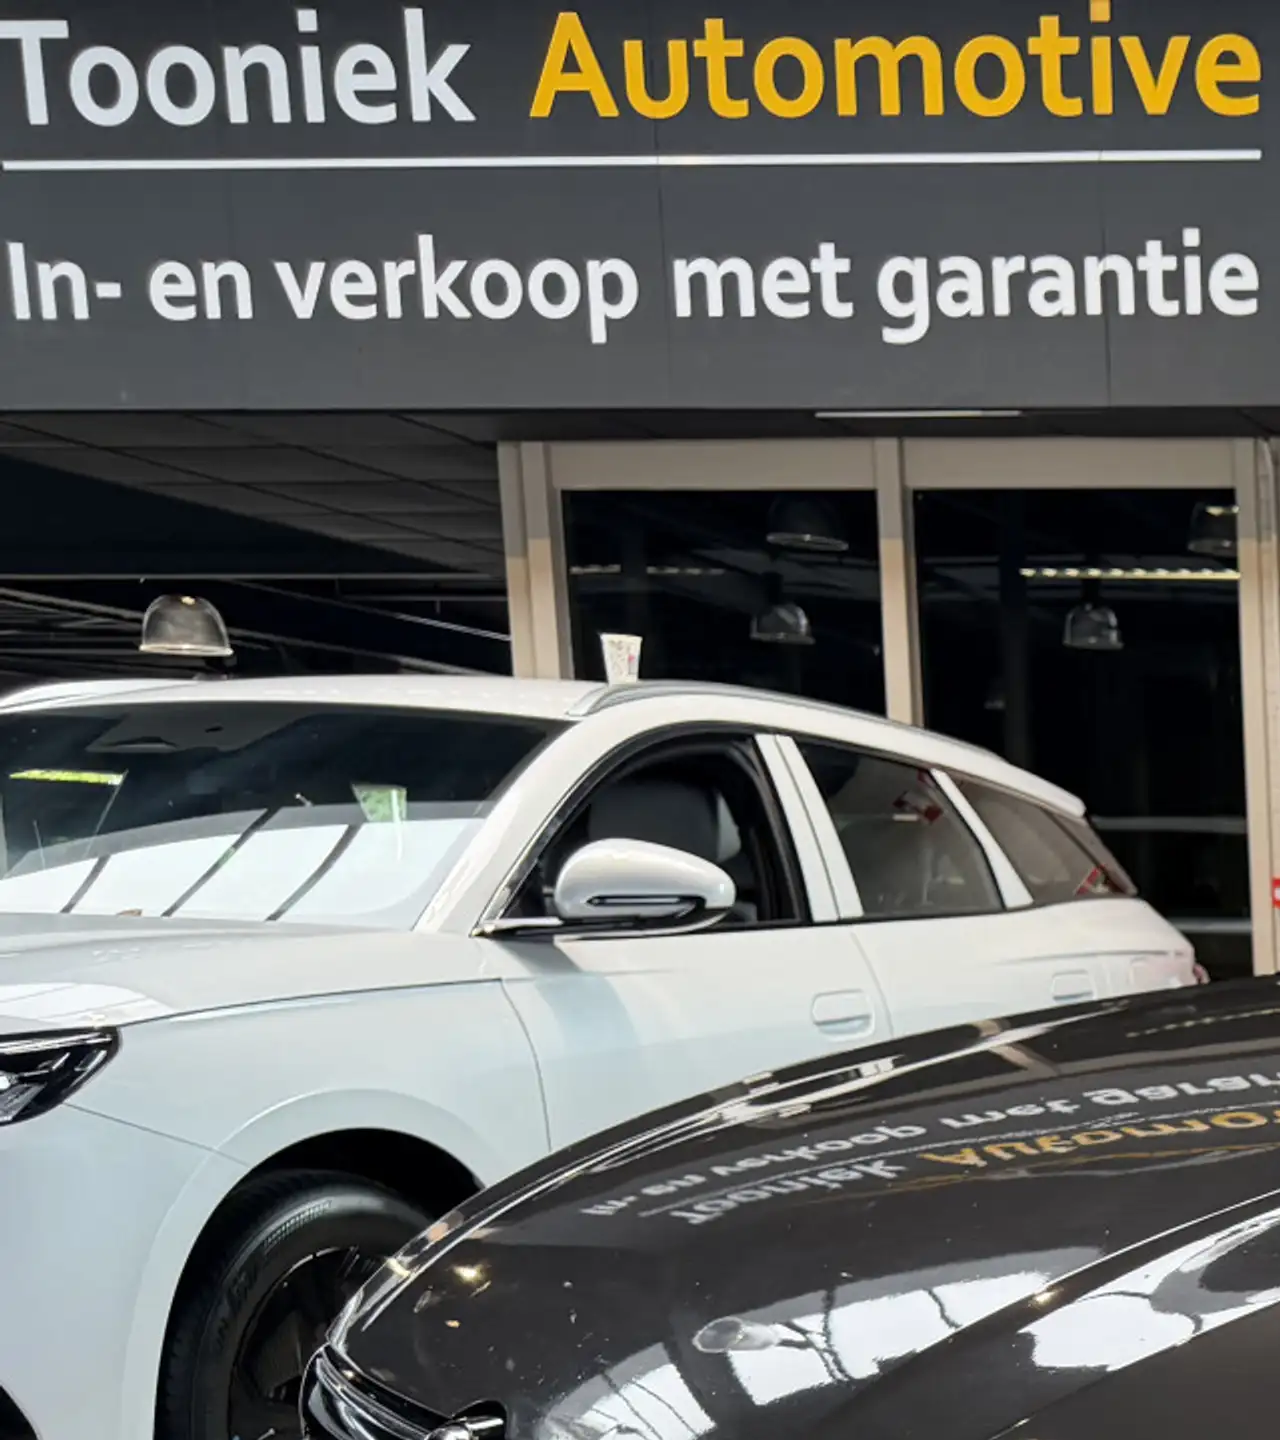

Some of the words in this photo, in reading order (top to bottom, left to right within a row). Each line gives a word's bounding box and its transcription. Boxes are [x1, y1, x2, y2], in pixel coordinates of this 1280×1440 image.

[0, 7, 476, 127] Tooniek
[529, 0, 1262, 120] Automotive
[7, 241, 122, 321] In-
[148, 260, 253, 322] en
[273, 233, 639, 345] verkoop
[672, 241, 854, 319] met
[876, 227, 1260, 345] garantie
